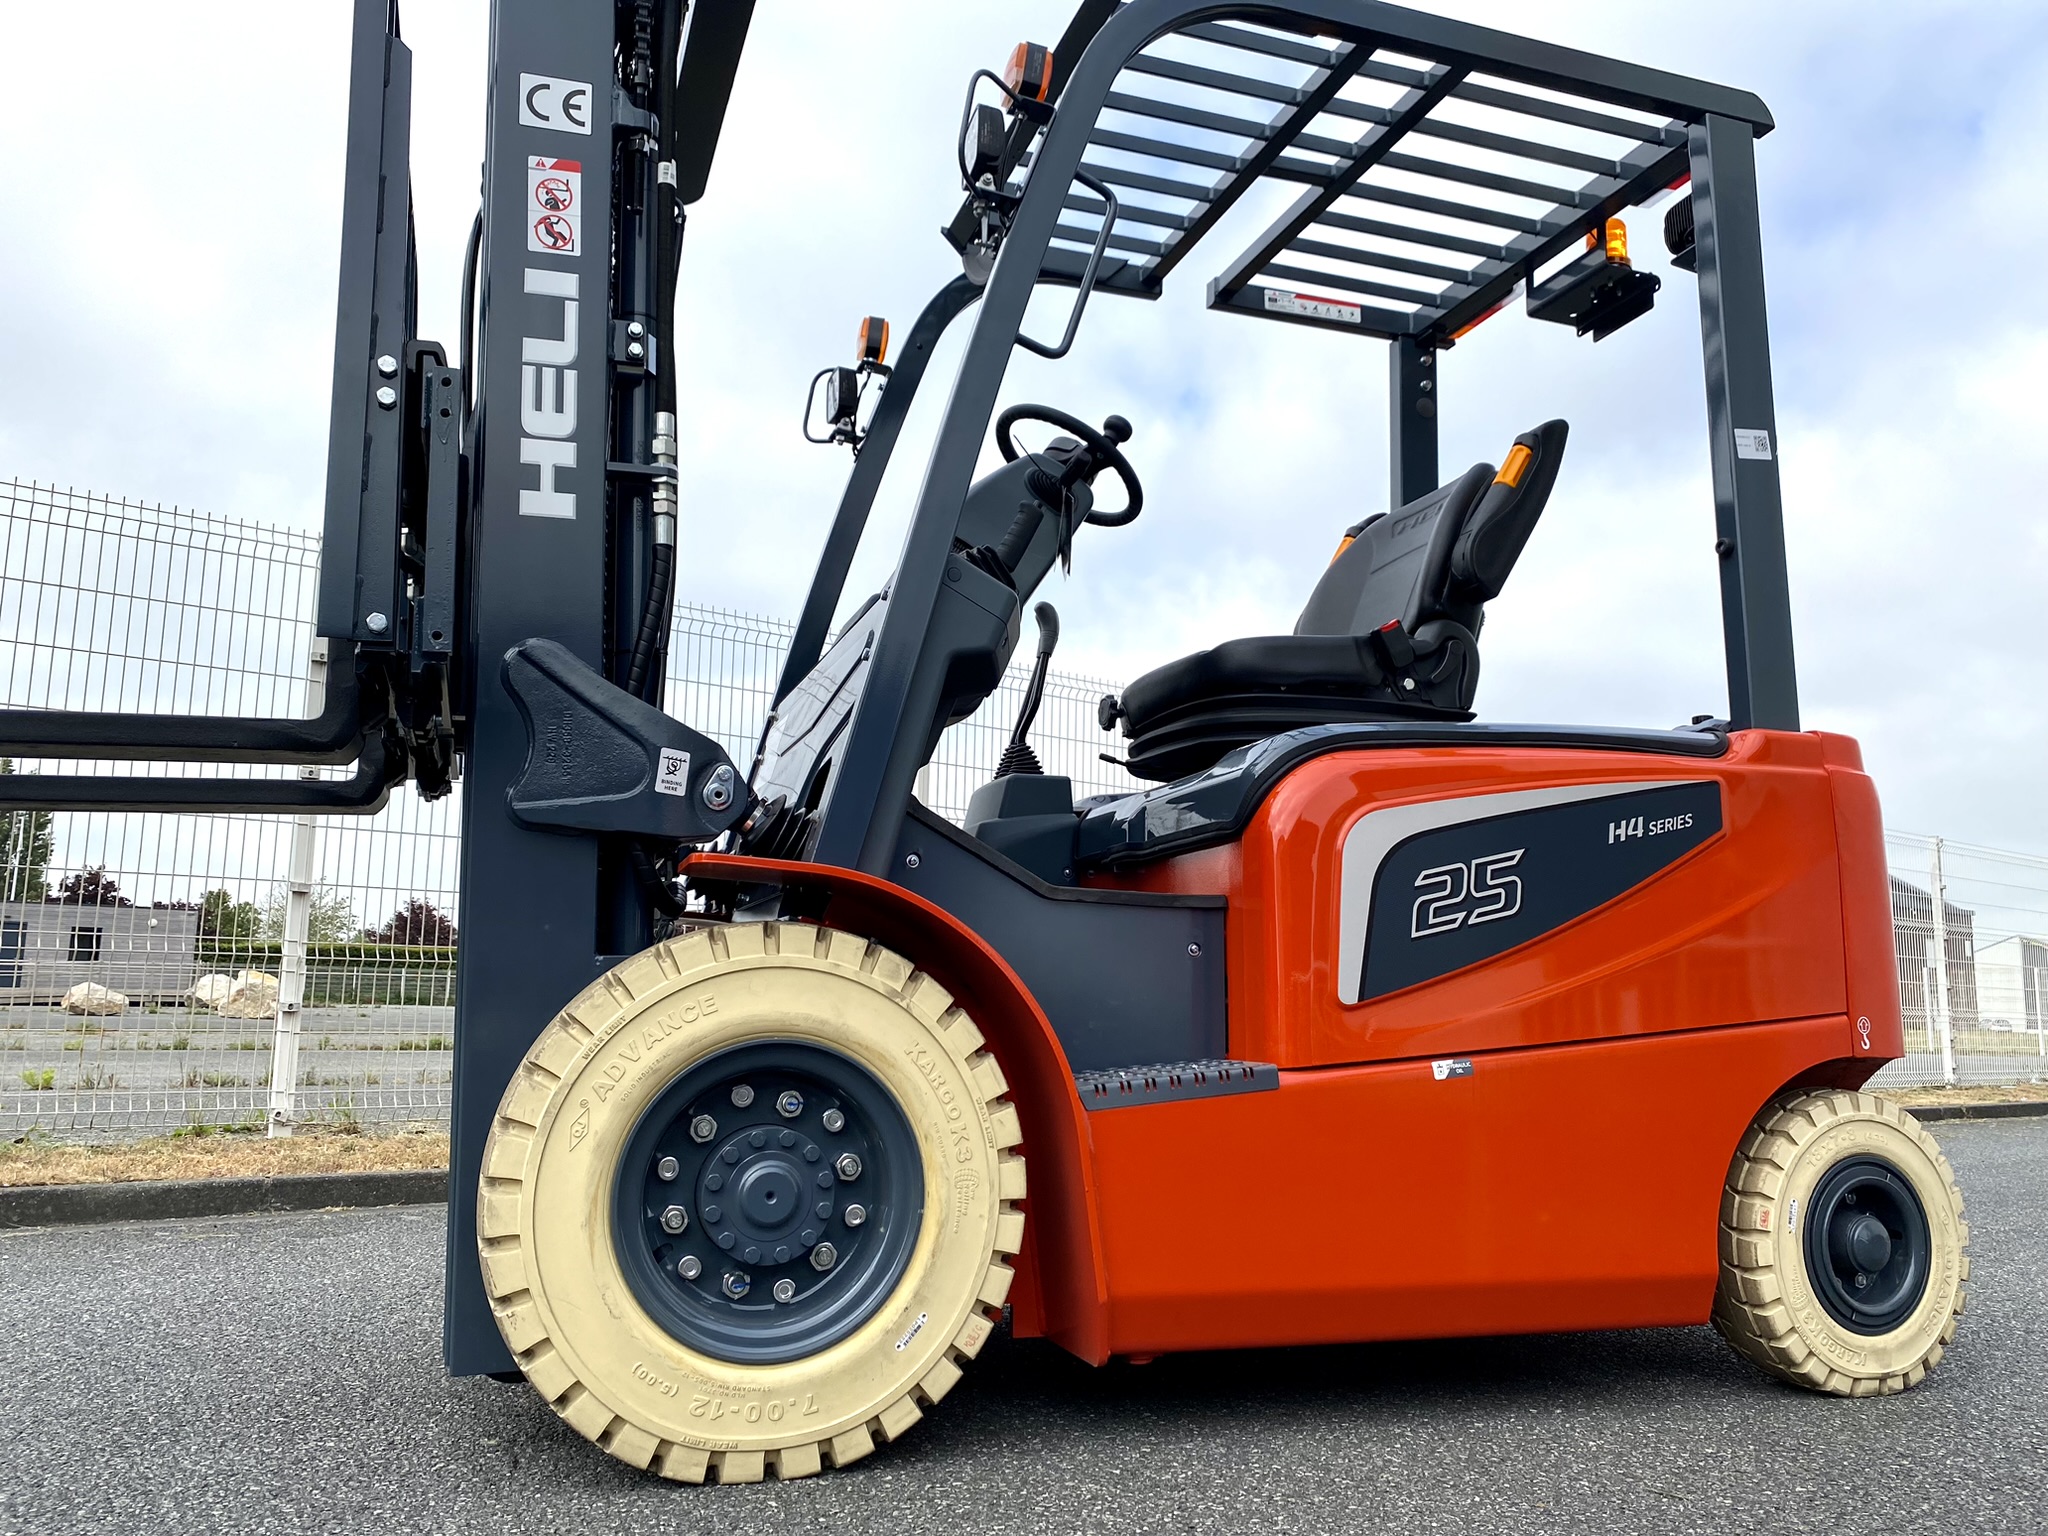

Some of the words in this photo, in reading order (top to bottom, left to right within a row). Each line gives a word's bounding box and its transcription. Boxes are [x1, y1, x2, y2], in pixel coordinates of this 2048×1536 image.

[526, 84, 586, 127] CE
[519, 268, 579, 520] HELI
[661, 779, 682, 787] BINDING
[1608, 816, 1644, 844] H4
[1648, 813, 1693, 836] SERIES
[1411, 848, 1525, 938] 25
[582, 1036, 605, 1060] WEAR
[605, 1016, 627, 1036] LIMIT
[592, 993, 718, 1103] ADVANCE
[620, 1083, 636, 1102] SOLID
[904, 1040, 961, 1121] KARGO
[950, 1124, 973, 1163] K3
[1923, 1244, 1954, 1337] ADVANCE
[632, 1361, 680, 1399] (5.00)
[732, 1385, 771, 1393] STANDARD
[688, 1393, 820, 1424] 7.00-12
[680, 1435, 707, 1448] LIMIT
[711, 1439, 739, 1450] WEAR
